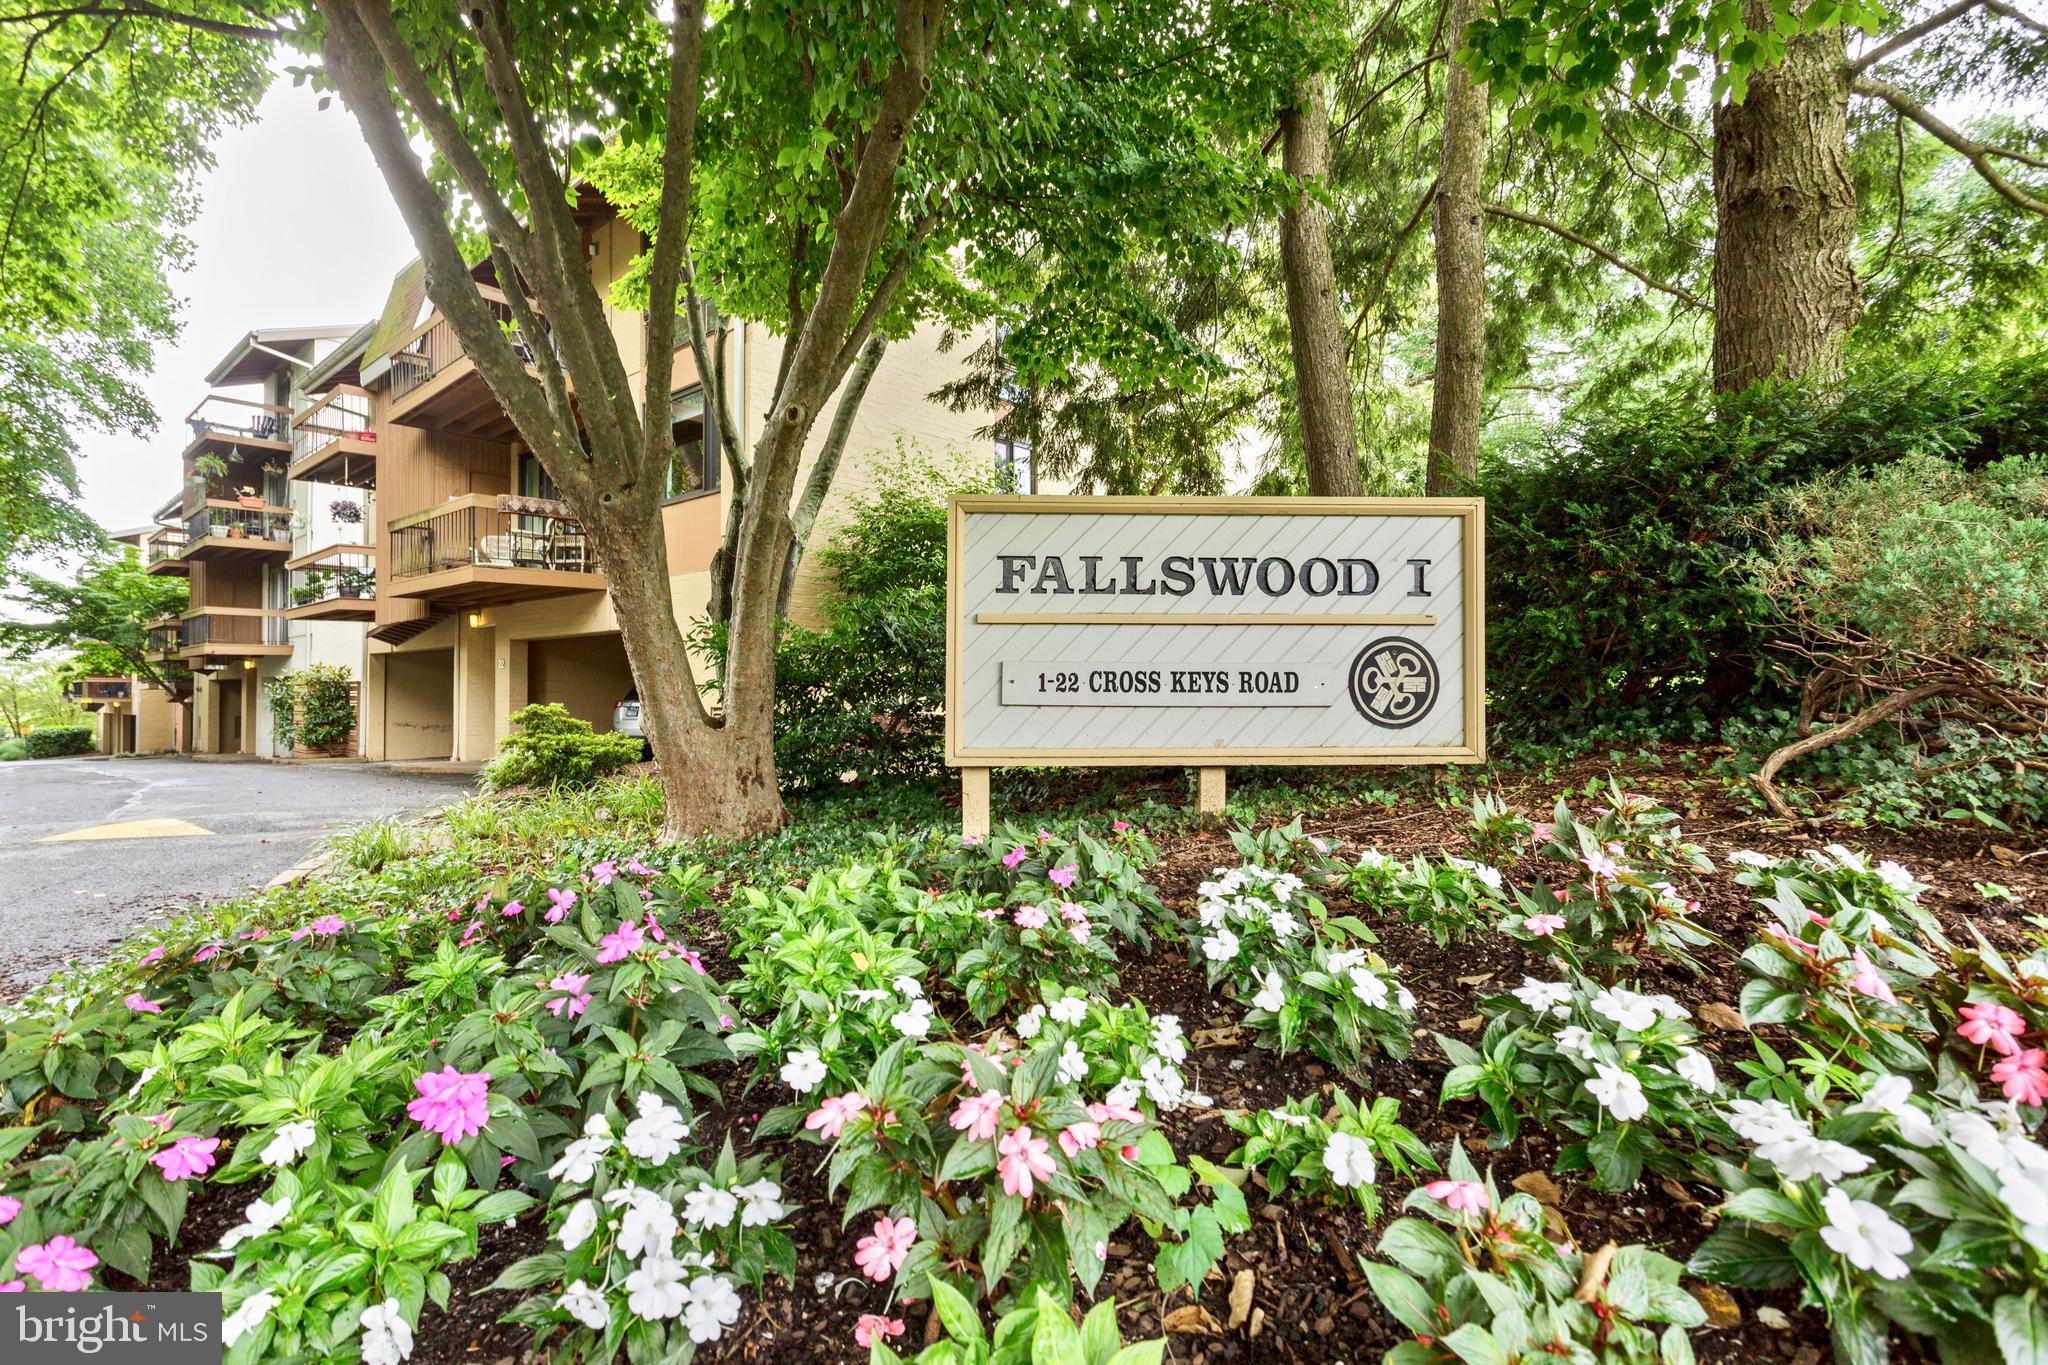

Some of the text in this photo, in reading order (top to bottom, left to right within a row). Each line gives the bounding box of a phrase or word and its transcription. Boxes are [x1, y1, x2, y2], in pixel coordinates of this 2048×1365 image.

[995, 555, 1432, 597] FALLSWOOD I
[1038, 670, 1300, 694] 1-22 CROSS KEYS ROAD
